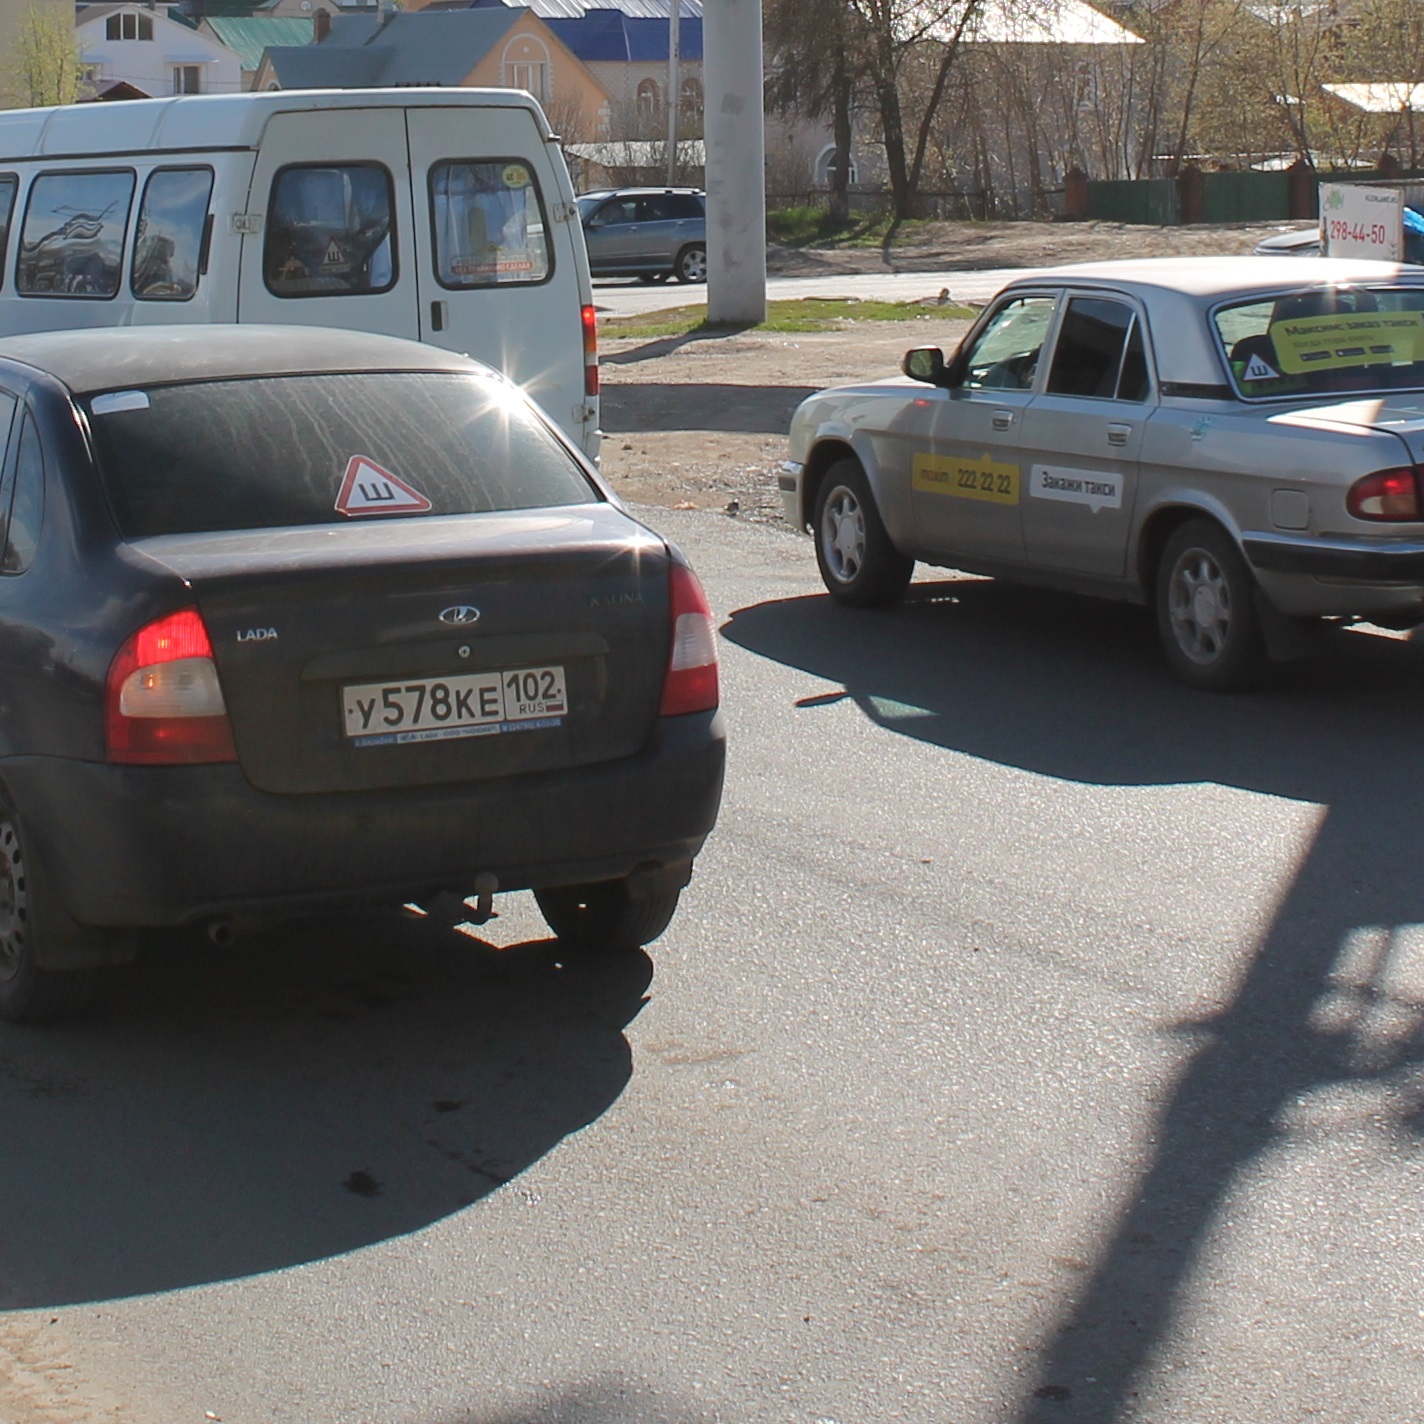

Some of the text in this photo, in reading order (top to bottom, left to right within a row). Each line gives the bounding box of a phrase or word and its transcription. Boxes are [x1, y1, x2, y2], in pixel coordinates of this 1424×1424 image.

[1330, 220, 1385, 244] 298-44-50
[328, 251, 340, 262] Ш
[1251, 365, 1268, 376] Ш
[957, 468, 976, 489] 222
[980, 471, 994, 492] 22
[997, 474, 1011, 495] 22
[1041, 471, 1116, 497] Закажи такси
[357, 482, 396, 501] Ш
[236, 627, 278, 642] LADA
[355, 671, 556, 729] У578КЕ 102
[519, 701, 546, 715] RUS
